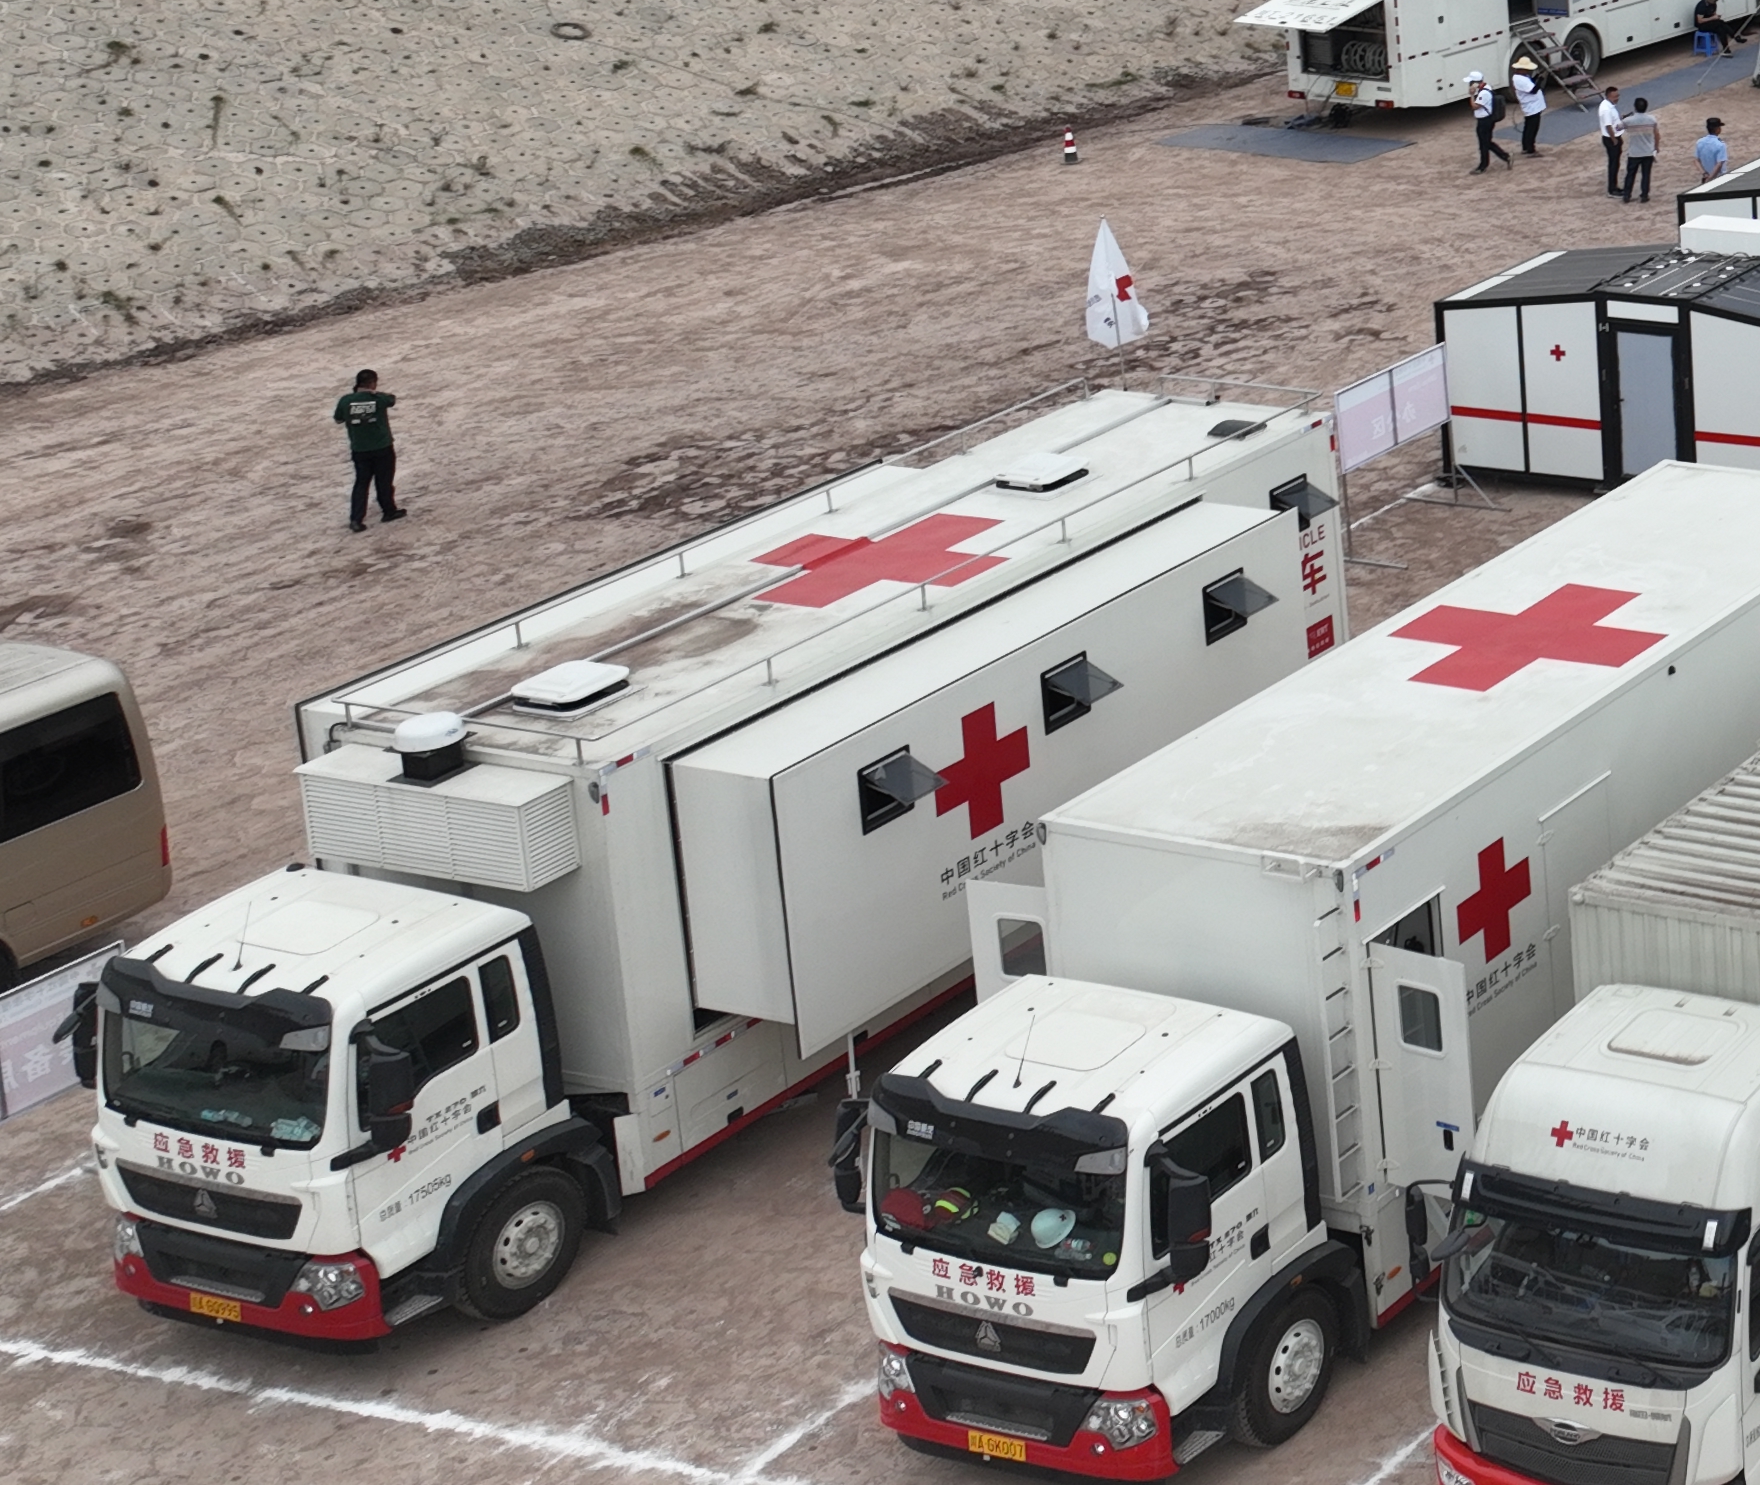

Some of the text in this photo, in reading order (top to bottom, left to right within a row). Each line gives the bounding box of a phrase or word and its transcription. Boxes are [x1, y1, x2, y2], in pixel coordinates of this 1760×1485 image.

[1301, 550, 1327, 595] 车
[940, 821, 1035, 885] 中国红十字会
[942, 886, 957, 901] Red
[980, 859, 1006, 879] Society
[1007, 852, 1015, 863] of
[1016, 841, 1036, 857] China
[1466, 943, 1536, 1005] 中国红十字会
[407, 1104, 471, 1144] 中国红十字会
[1576, 1126, 1650, 1151] 中国红十字会
[153, 1132, 247, 1169] 应急救援
[157, 1155, 246, 1186] HOWO
[932, 1258, 1036, 1297] 应急救援
[935, 1284, 1035, 1317] HOWO
[1517, 1371, 1626, 1412] 应急救援
